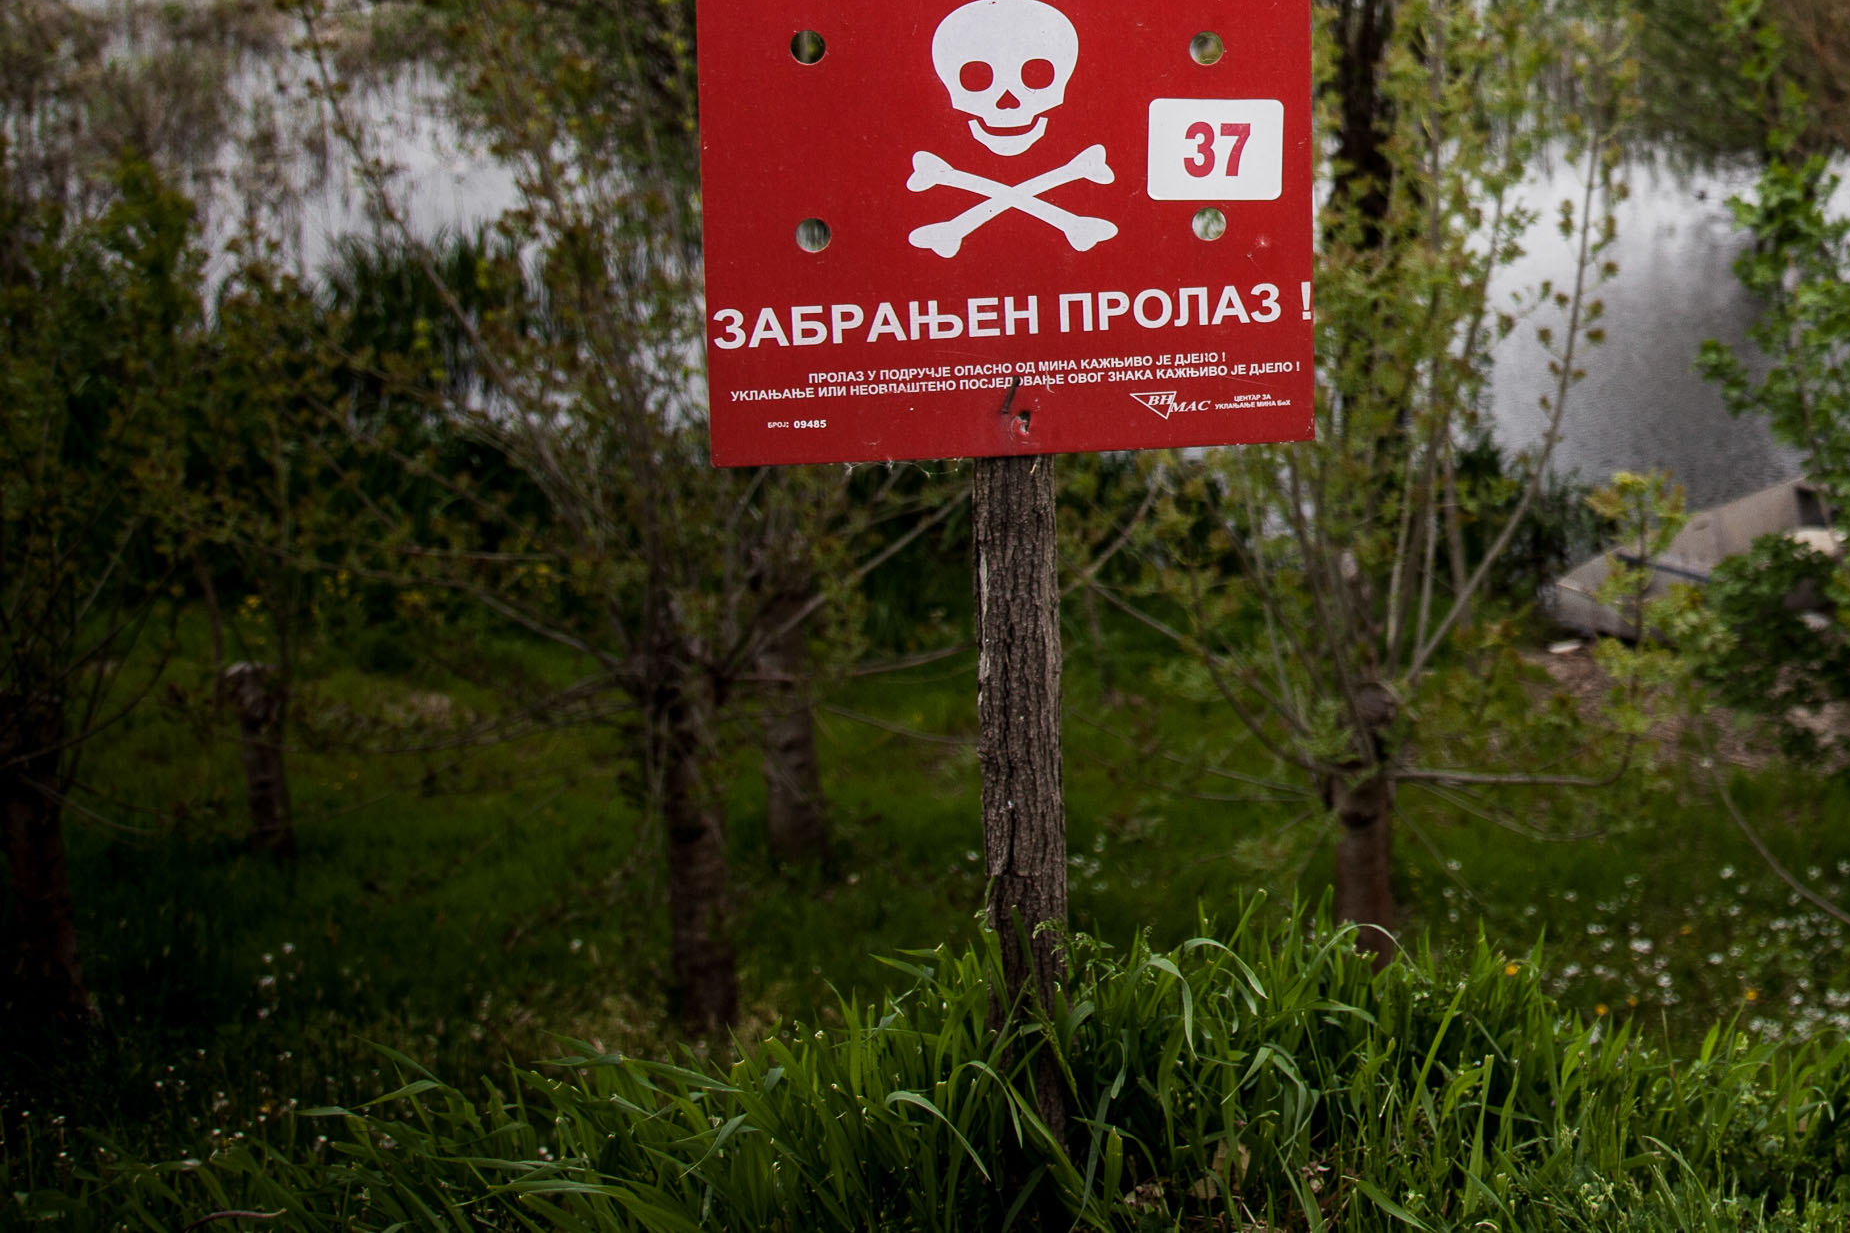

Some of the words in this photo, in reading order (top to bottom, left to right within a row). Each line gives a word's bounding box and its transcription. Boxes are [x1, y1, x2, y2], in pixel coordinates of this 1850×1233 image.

[1184, 121, 1251, 178] 37
[713, 295, 1039, 349] ЗАБРАЊЕН
[1059, 283, 1282, 334] ПРОЛАЗ
[1300, 281, 1312, 321] !
[731, 387, 815, 402] УКЛАЊАЊЕ
[818, 385, 847, 397] ИЛИ
[850, 380, 956, 396] НЕОВЛАШТЕНО
[1068, 372, 1104, 384] ОВОГ
[1108, 369, 1153, 382] ЗНАКА
[1156, 365, 1228, 380] КАЖЊИВО
[1230, 363, 1246, 375] ЈЕ
[1249, 361, 1293, 376] ДЈЕЛО
[1296, 361, 1300, 372] !
[808, 370, 864, 384] ПРОЛАЗ
[867, 370, 876, 381] У
[880, 366, 951, 381] ПОДРУЧЈЕ
[954, 363, 1012, 376] ОПАСНО
[1015, 362, 1035, 374] ОД
[1038, 360, 1078, 371] МИНА
[1081, 356, 1153, 370] КАЖЊИВО
[1156, 354, 1172, 365] ЈЕ
[1221, 352, 1226, 363] !
[793, 419, 827, 429] 09485
[1169, 400, 1211, 413] MAC
